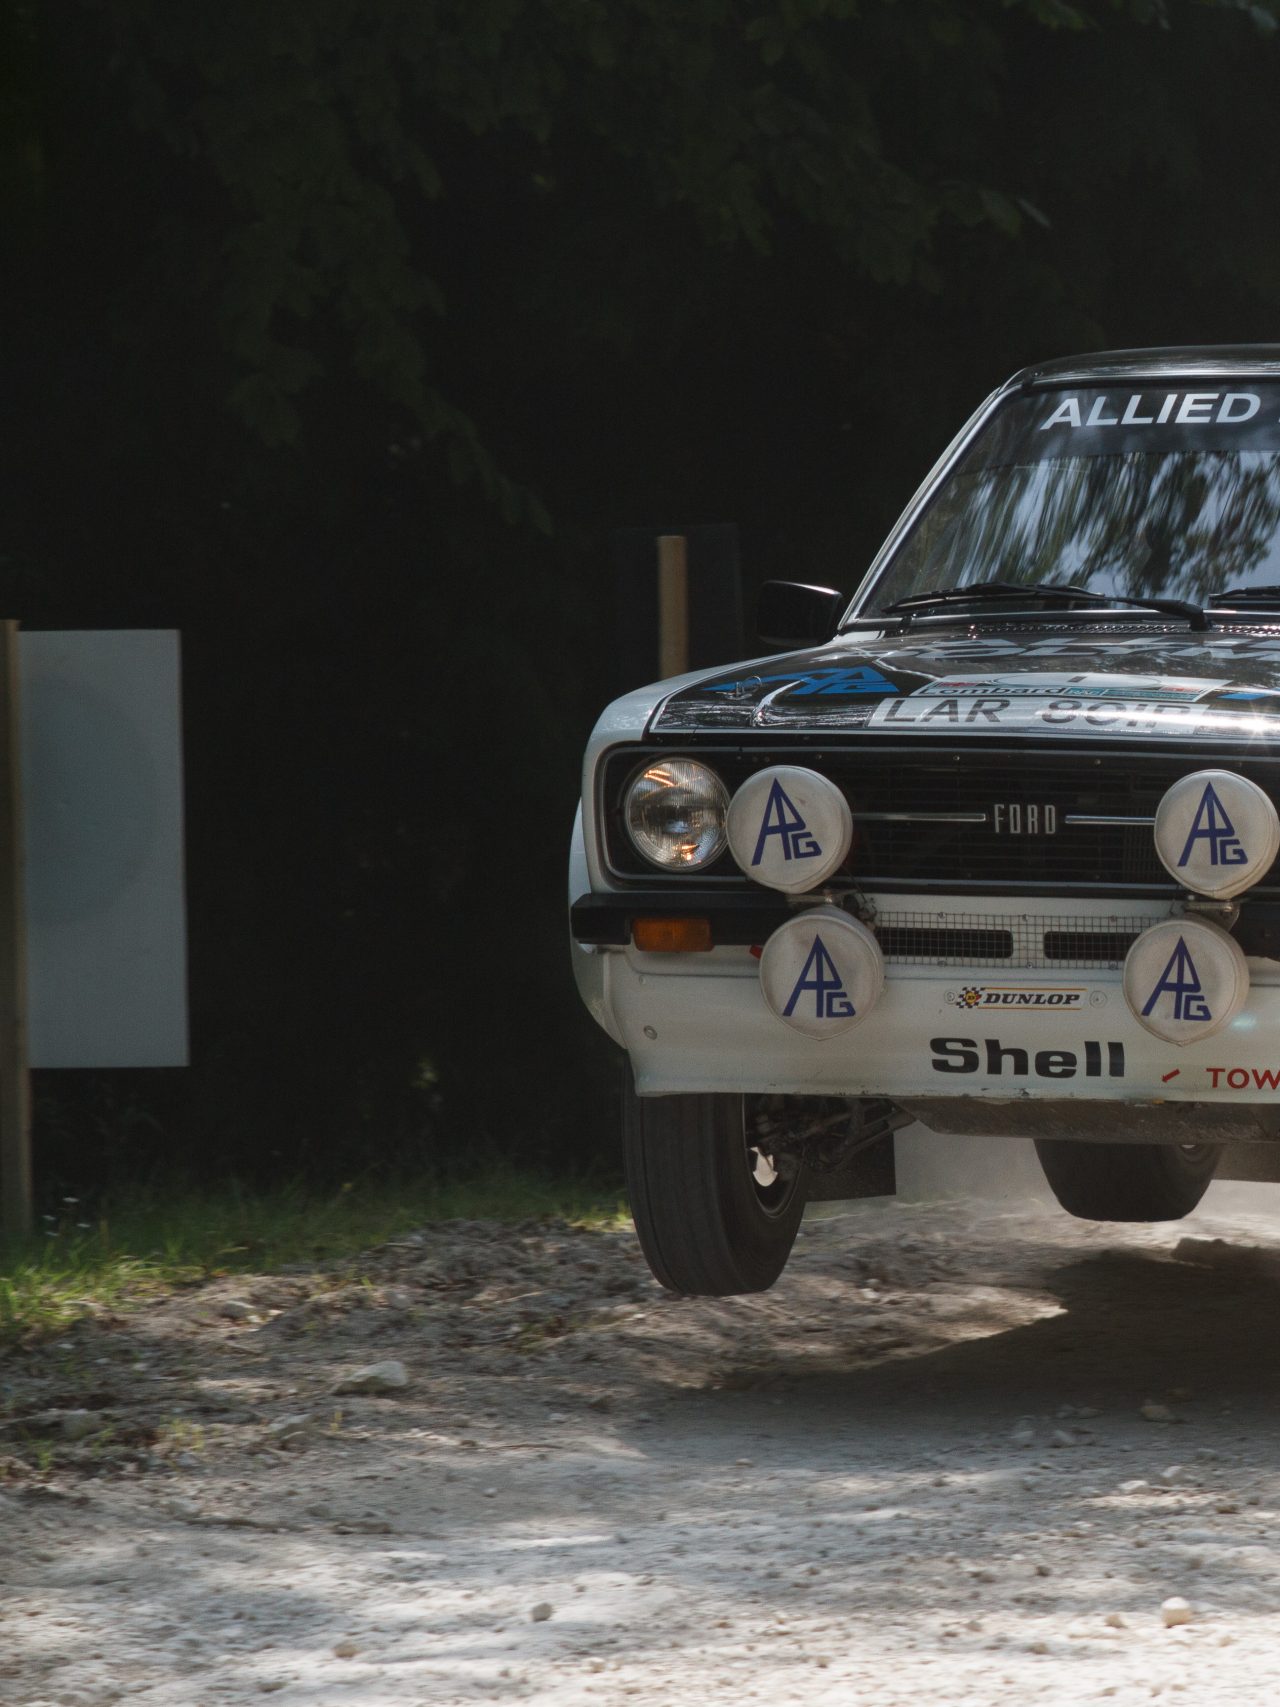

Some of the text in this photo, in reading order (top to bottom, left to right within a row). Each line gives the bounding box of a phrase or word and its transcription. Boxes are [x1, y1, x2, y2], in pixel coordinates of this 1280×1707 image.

[1040, 392, 1261, 430] ALLIED
[918, 686, 1065, 696] Lombard
[882, 698, 1011, 723] LAR
[993, 803, 1057, 836] FORD
[983, 992, 1081, 1005] DUNLOP
[929, 1036, 1126, 1080] Shell
